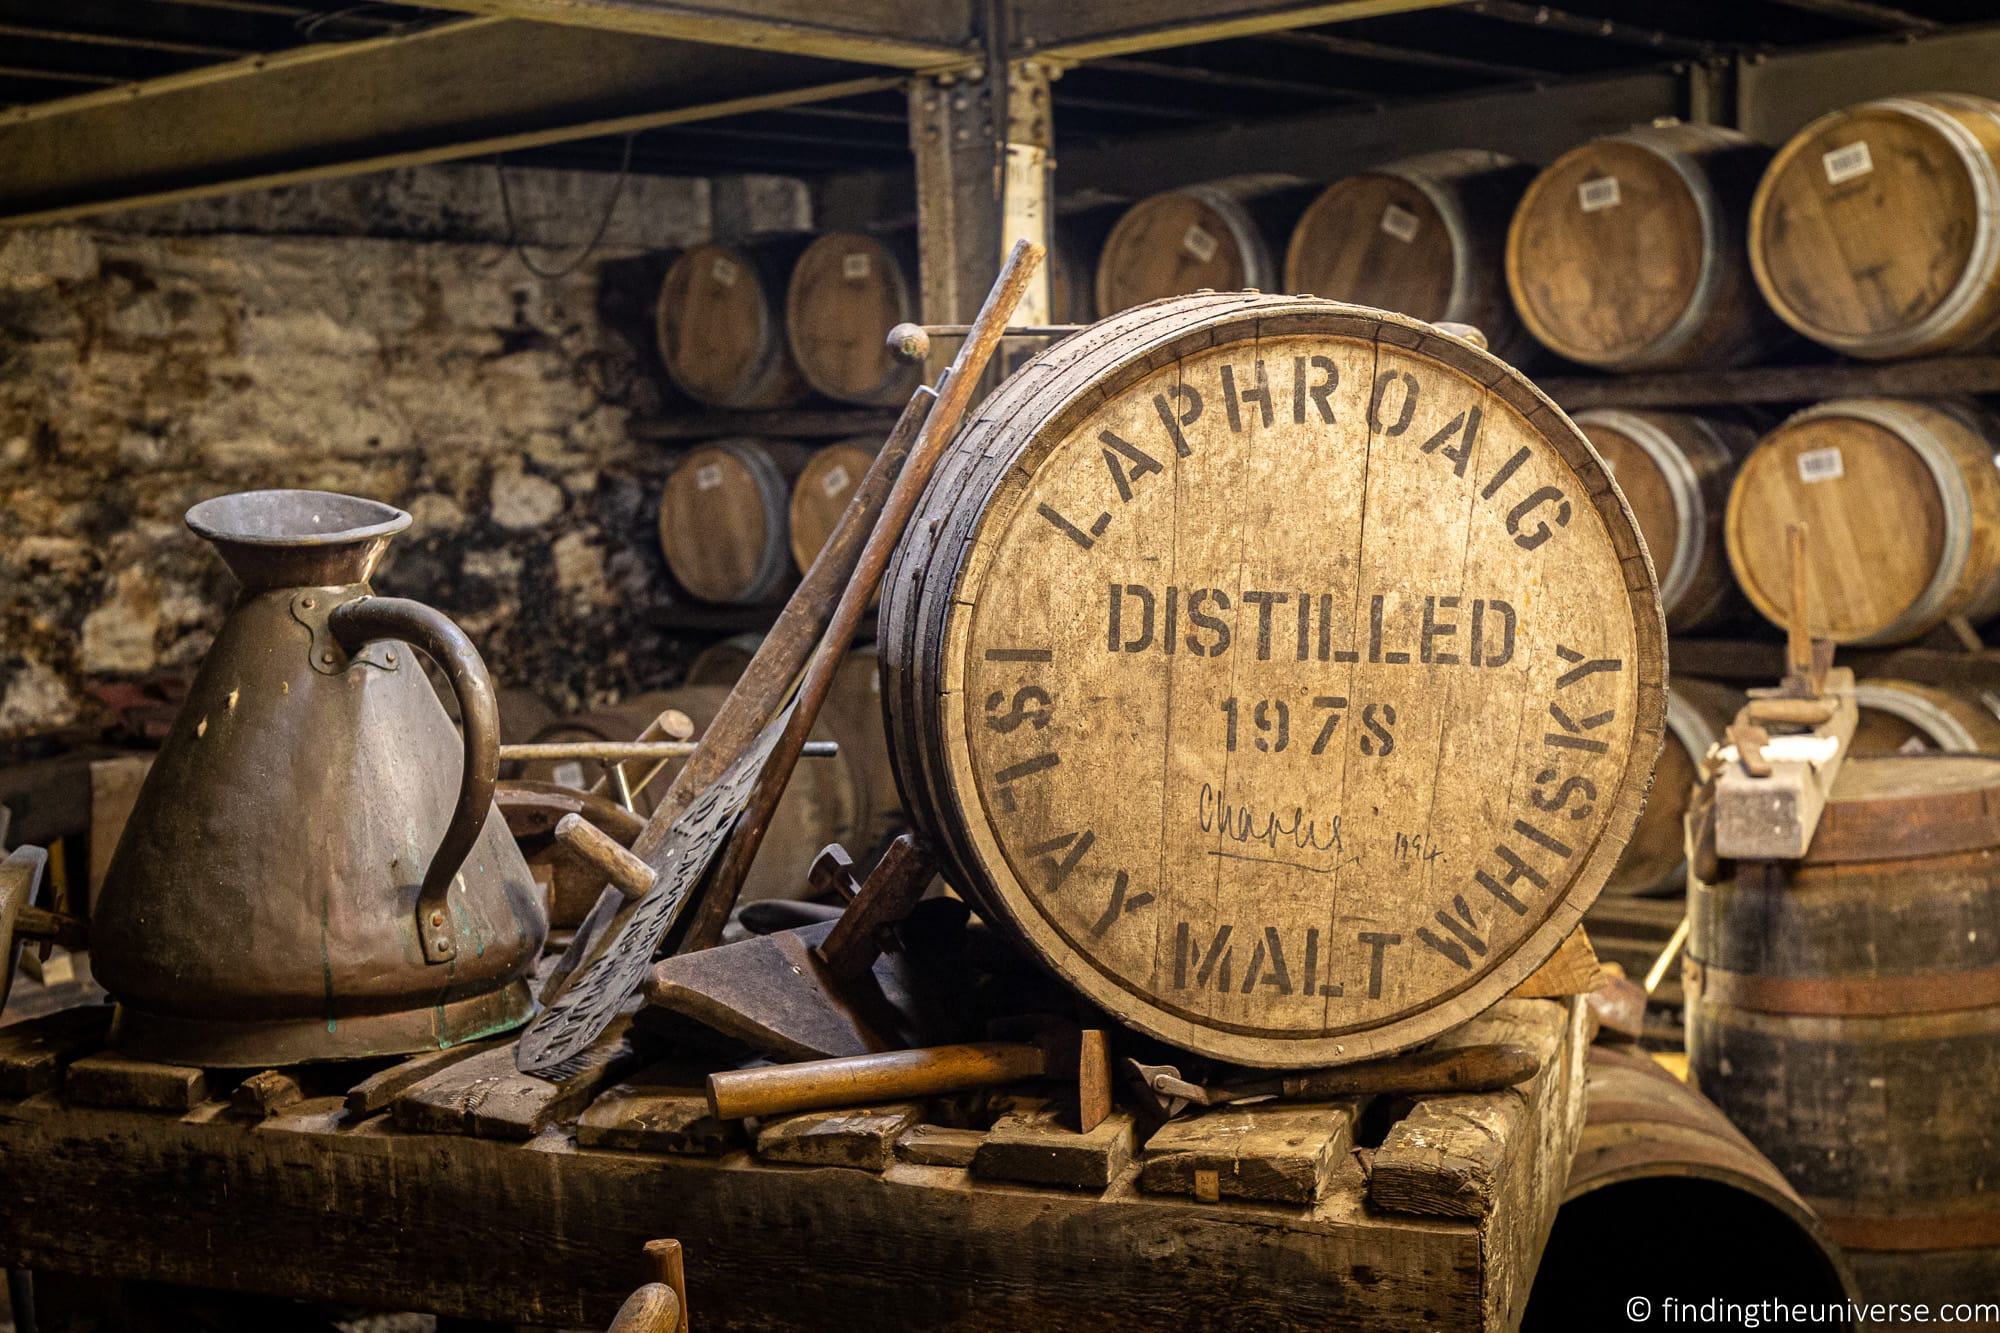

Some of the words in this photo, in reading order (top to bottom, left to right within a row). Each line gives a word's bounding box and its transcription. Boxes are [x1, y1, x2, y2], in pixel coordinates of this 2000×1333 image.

[1037, 355, 1571, 551] LAPHROAIG
[1107, 583, 1517, 667] DISTILLED
[985, 648, 1155, 937] ISLAY
[1173, 921, 1402, 1000] MALT
[1416, 644, 1622, 970] WHISKY
